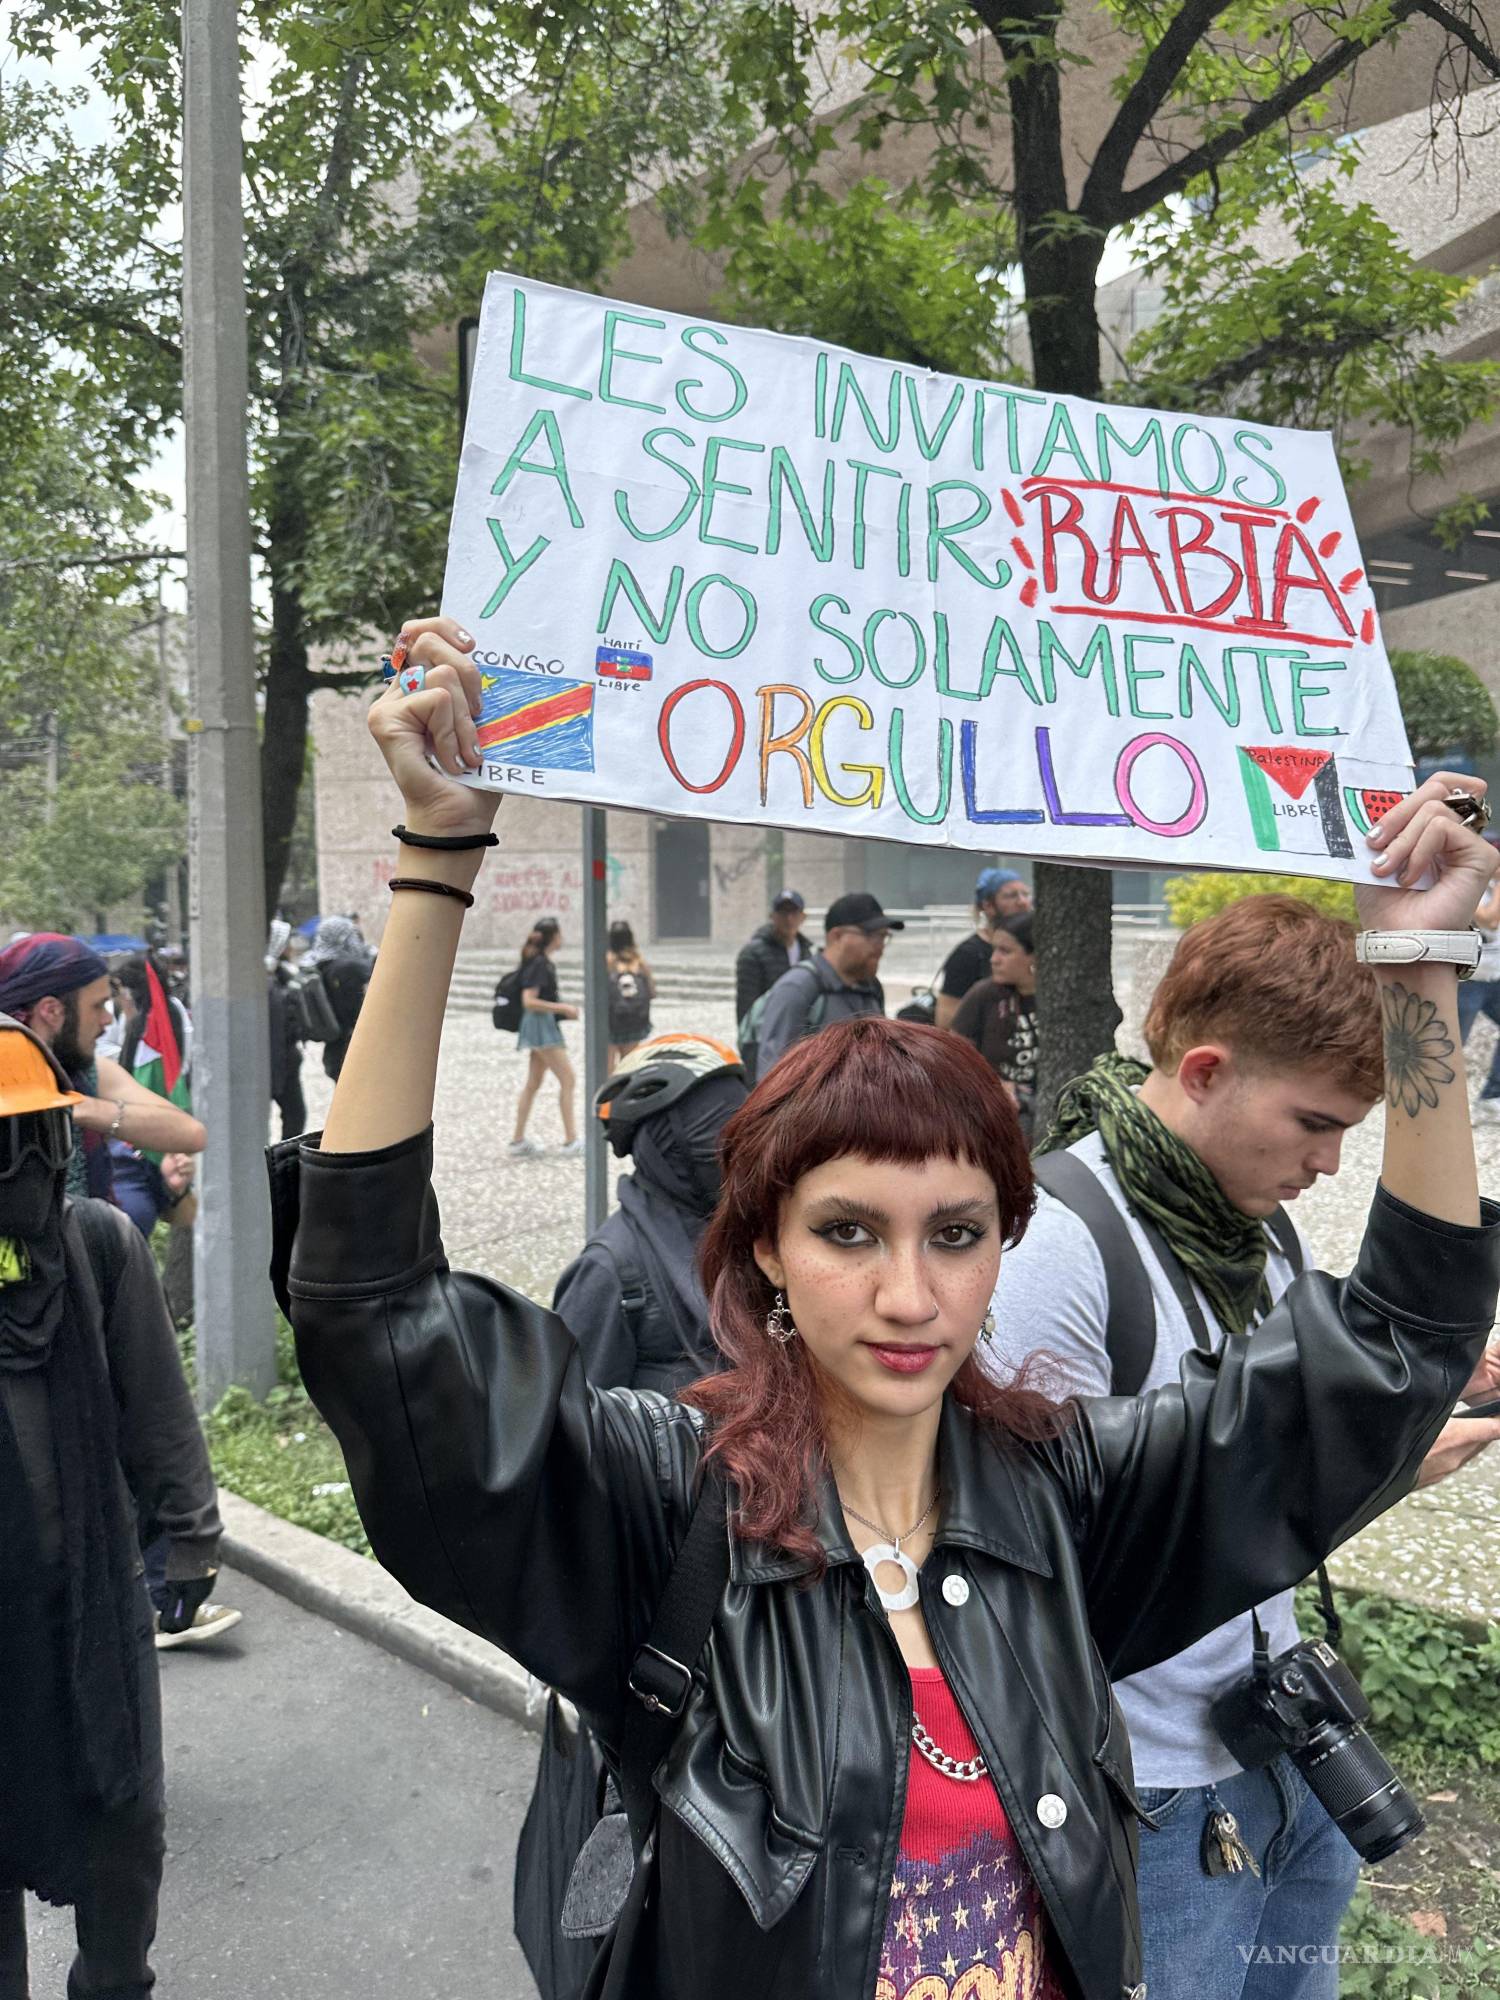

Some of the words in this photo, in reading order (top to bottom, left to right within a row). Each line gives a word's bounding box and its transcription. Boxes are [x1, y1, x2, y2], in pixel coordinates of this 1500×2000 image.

[509, 288, 748, 422] LES
[815, 352, 1286, 507] INVITAMOS
[490, 409, 585, 528] A
[614, 427, 1012, 589] SENTIR
[1022, 486, 1357, 637] RABIA
[472, 650, 565, 675] CONGO
[479, 517, 551, 619] Y
[596, 558, 758, 659] NO
[808, 593, 1349, 737] SOLAMENTE
[657, 679, 1208, 838] ORGULLO
[1272, 803, 1320, 818] LIBRE
